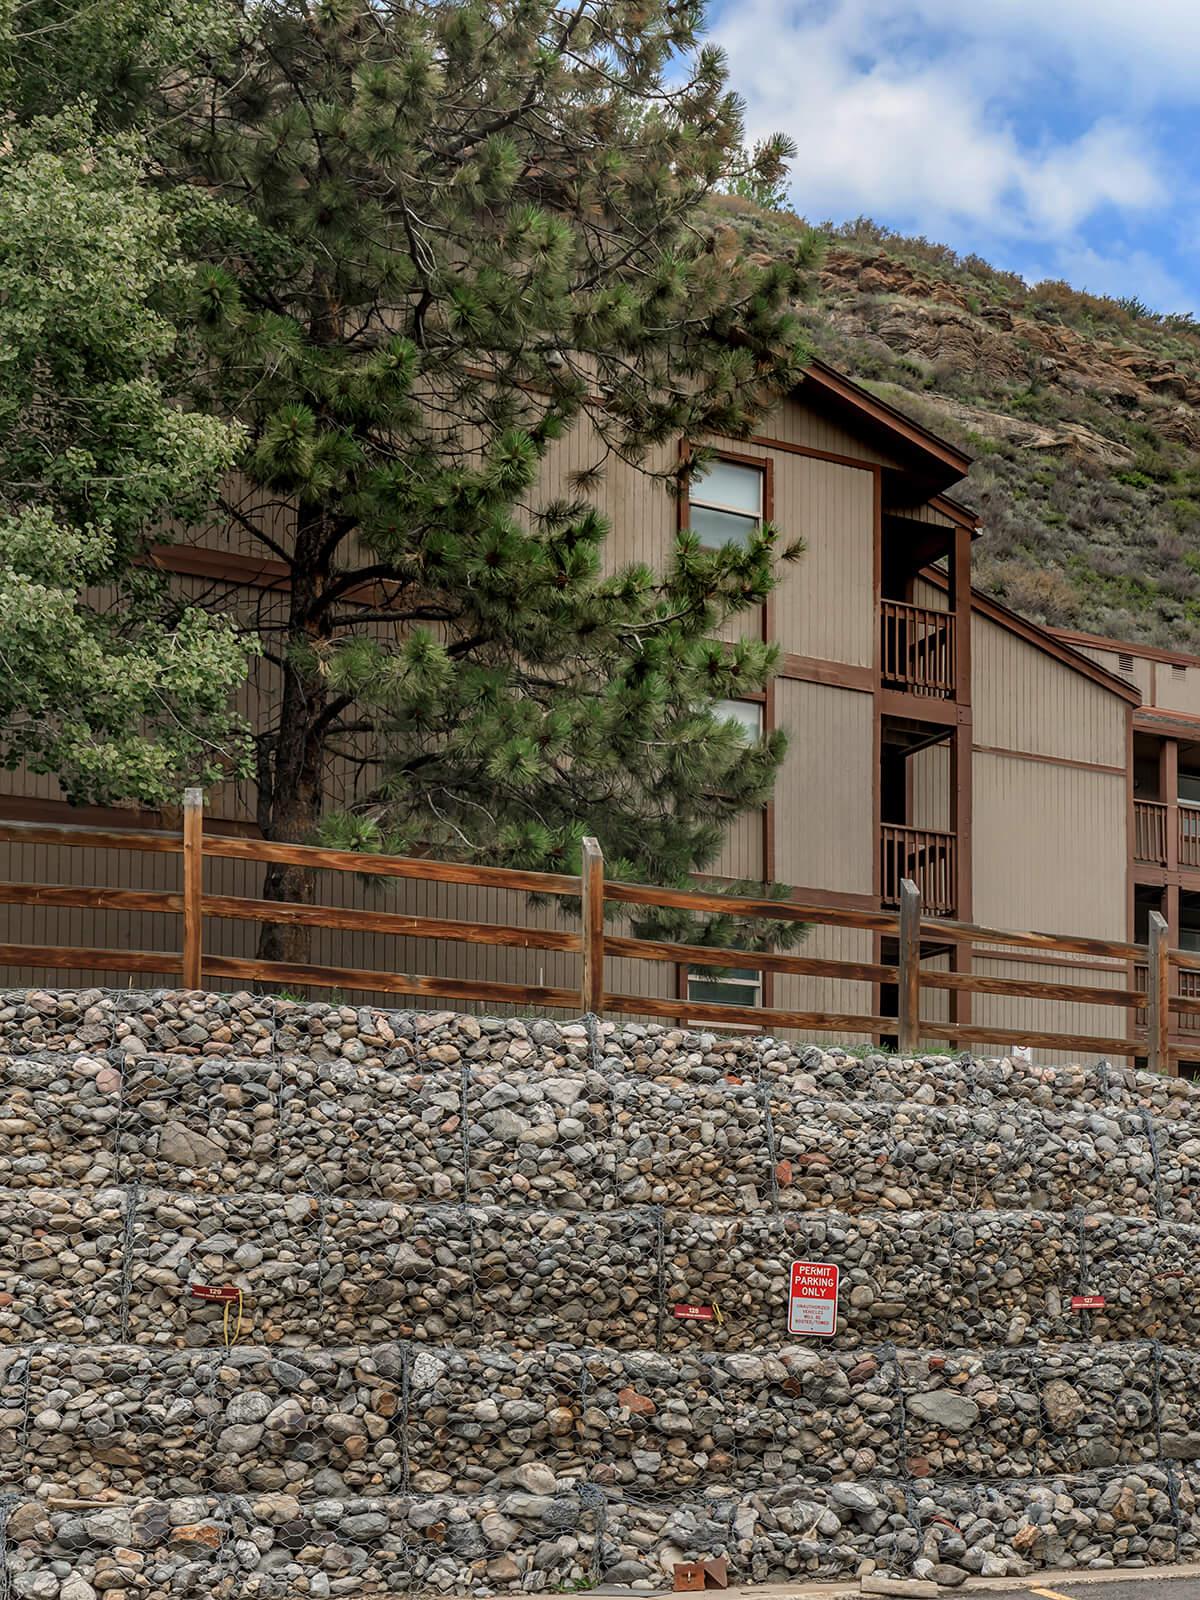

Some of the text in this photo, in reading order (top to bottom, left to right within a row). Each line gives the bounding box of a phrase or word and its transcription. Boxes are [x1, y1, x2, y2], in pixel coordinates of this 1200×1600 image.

[800, 1266, 831, 1276] PERMIT
[795, 1276, 834, 1287] PARKING
[801, 1287, 826, 1296] ONLY
